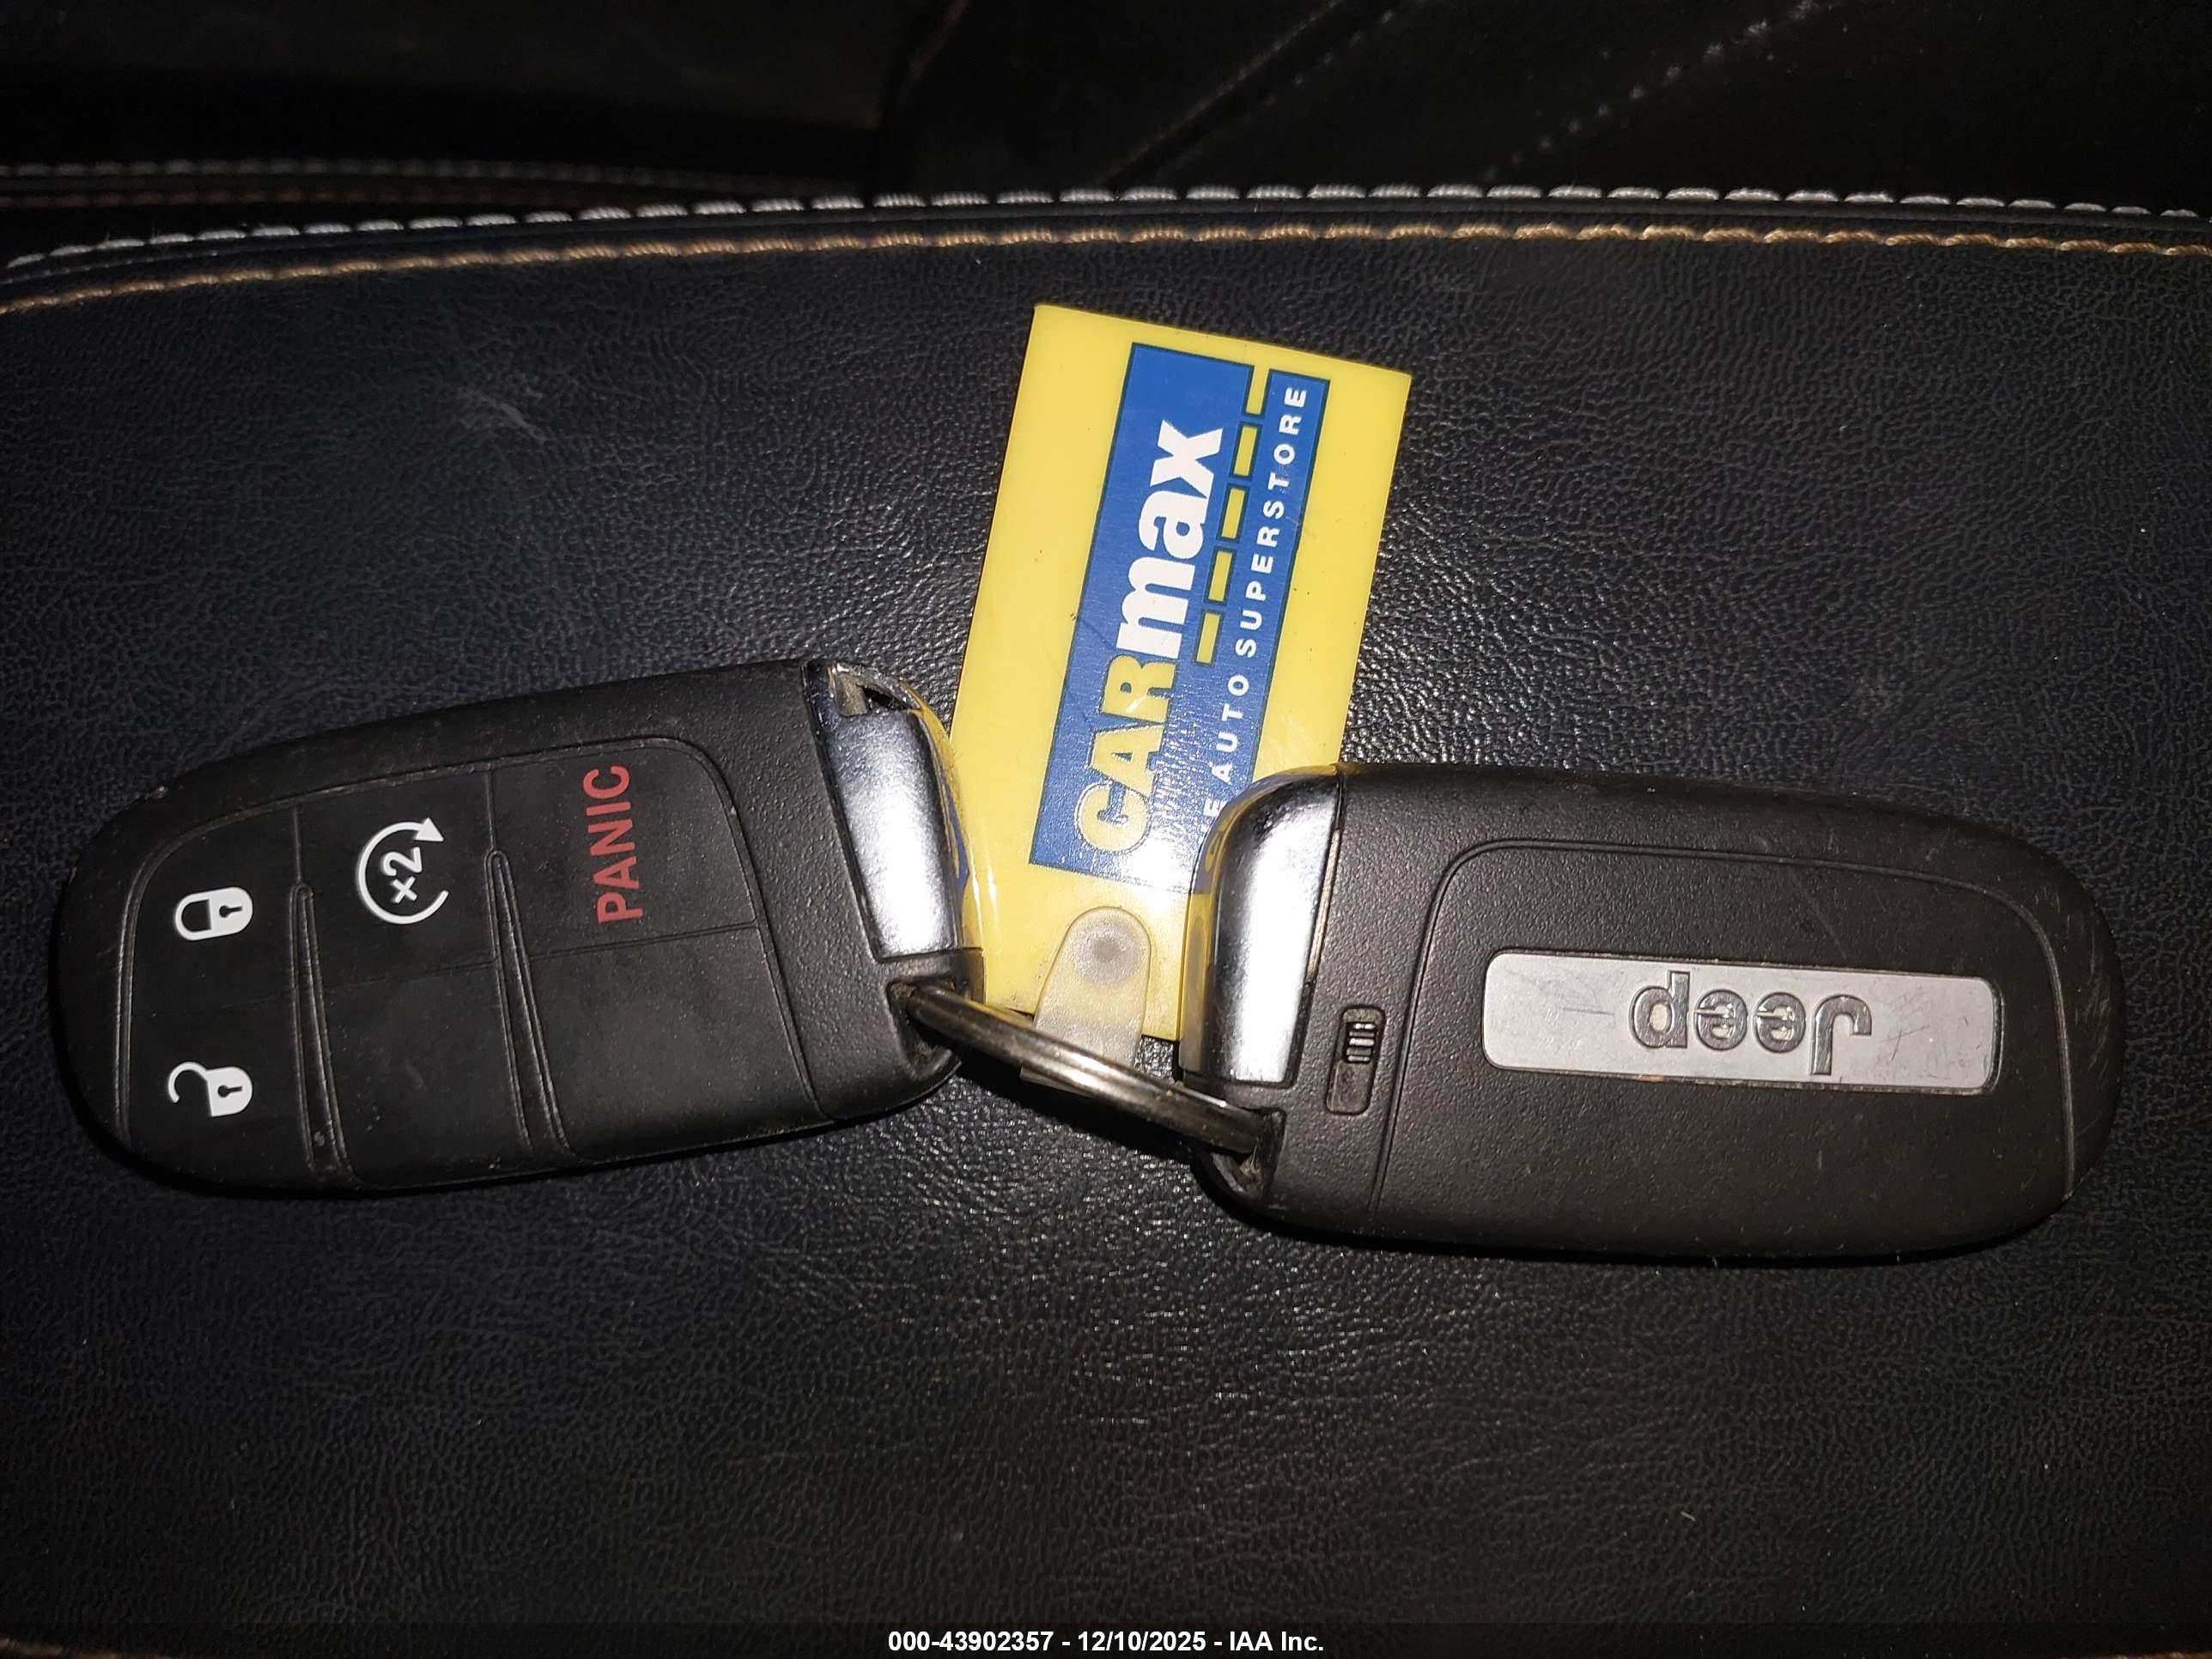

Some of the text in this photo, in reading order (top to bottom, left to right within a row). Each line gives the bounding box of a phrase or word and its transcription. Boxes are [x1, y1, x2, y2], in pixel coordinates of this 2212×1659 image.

[1209, 676, 1249, 784] AUTO
[1236, 387, 1306, 658] SUPERSTORE
[582, 765, 643, 923] PANIC
[1631, 971, 1872, 1075] Jeep
